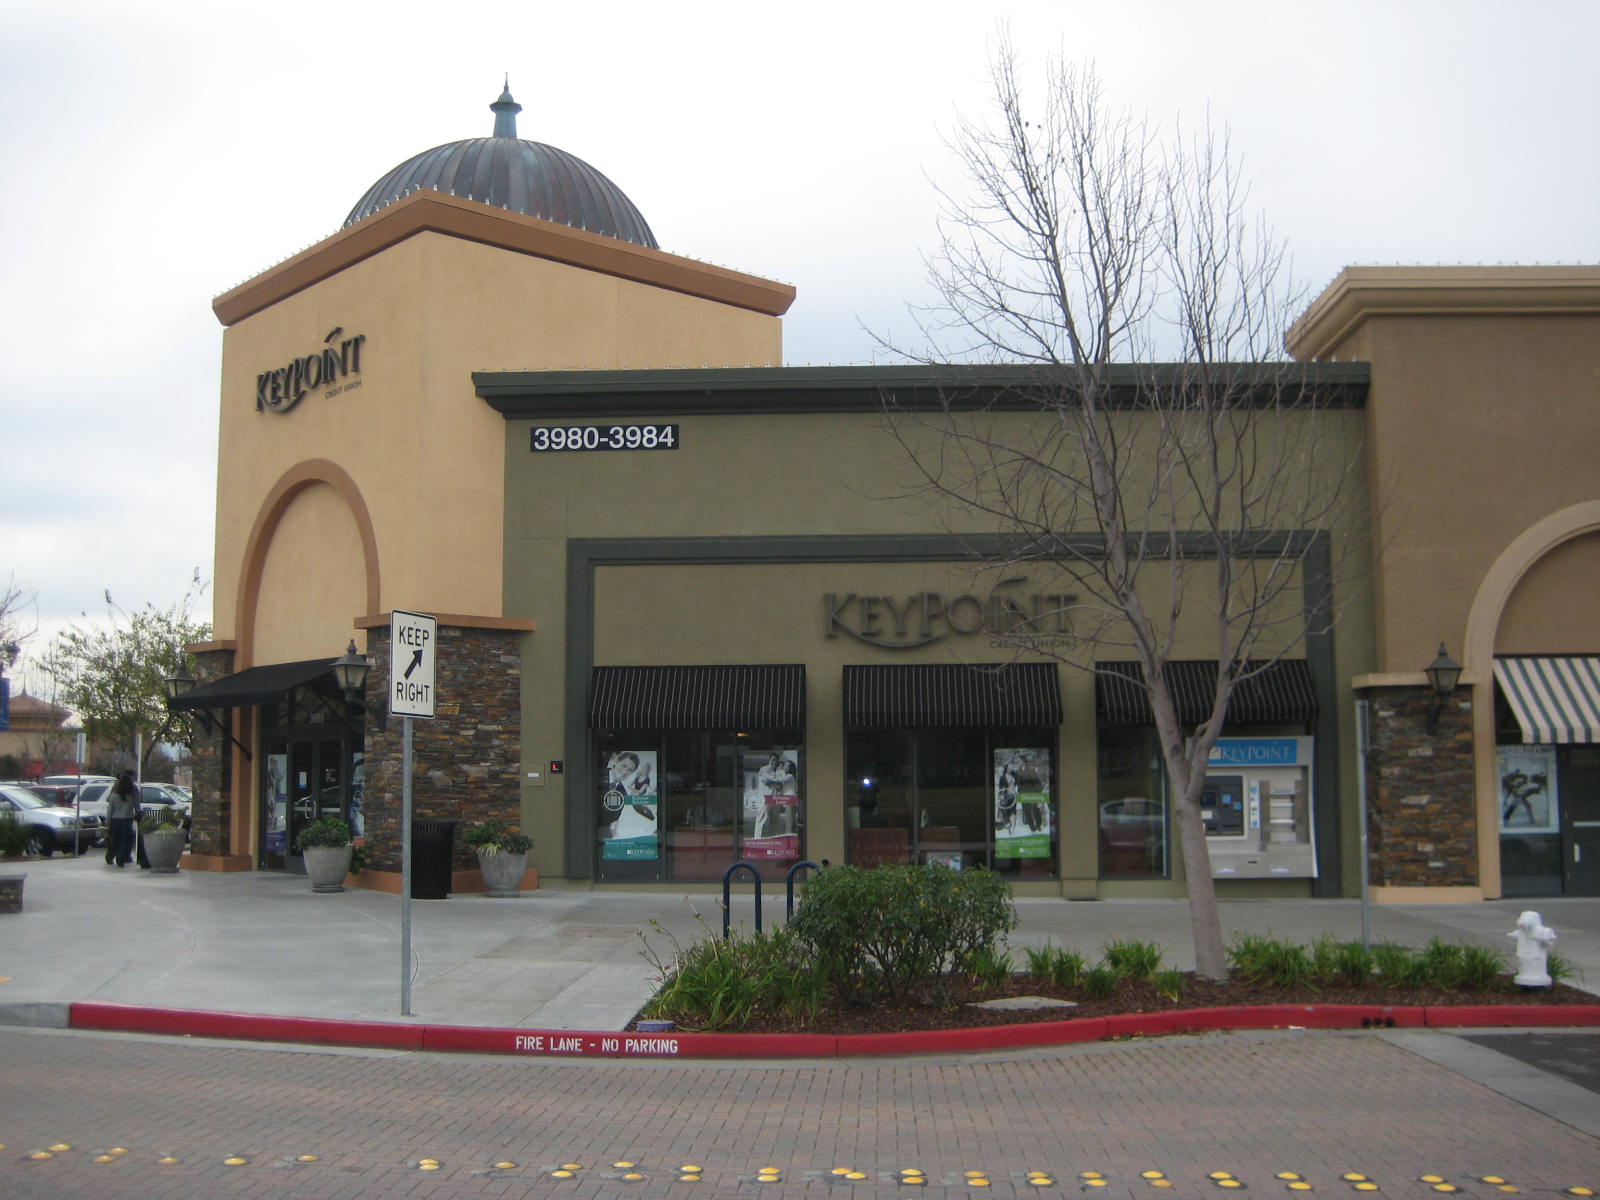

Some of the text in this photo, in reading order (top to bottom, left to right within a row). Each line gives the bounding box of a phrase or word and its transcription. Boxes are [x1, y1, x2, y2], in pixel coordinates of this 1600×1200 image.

[256, 327, 366, 413] KEYPOINT
[534, 425, 675, 450] 3980-3984
[823, 576, 1079, 649] KEYPOINT
[399, 626, 430, 648] KEEP
[396, 681, 430, 703] RIGHT
[1221, 742, 1291, 762] KEYPOINT
[516, 1036, 544, 1050] FIRE
[550, 1037, 583, 1051] LANE
[601, 1038, 619, 1051] NO
[625, 1038, 679, 1054] PARKING
